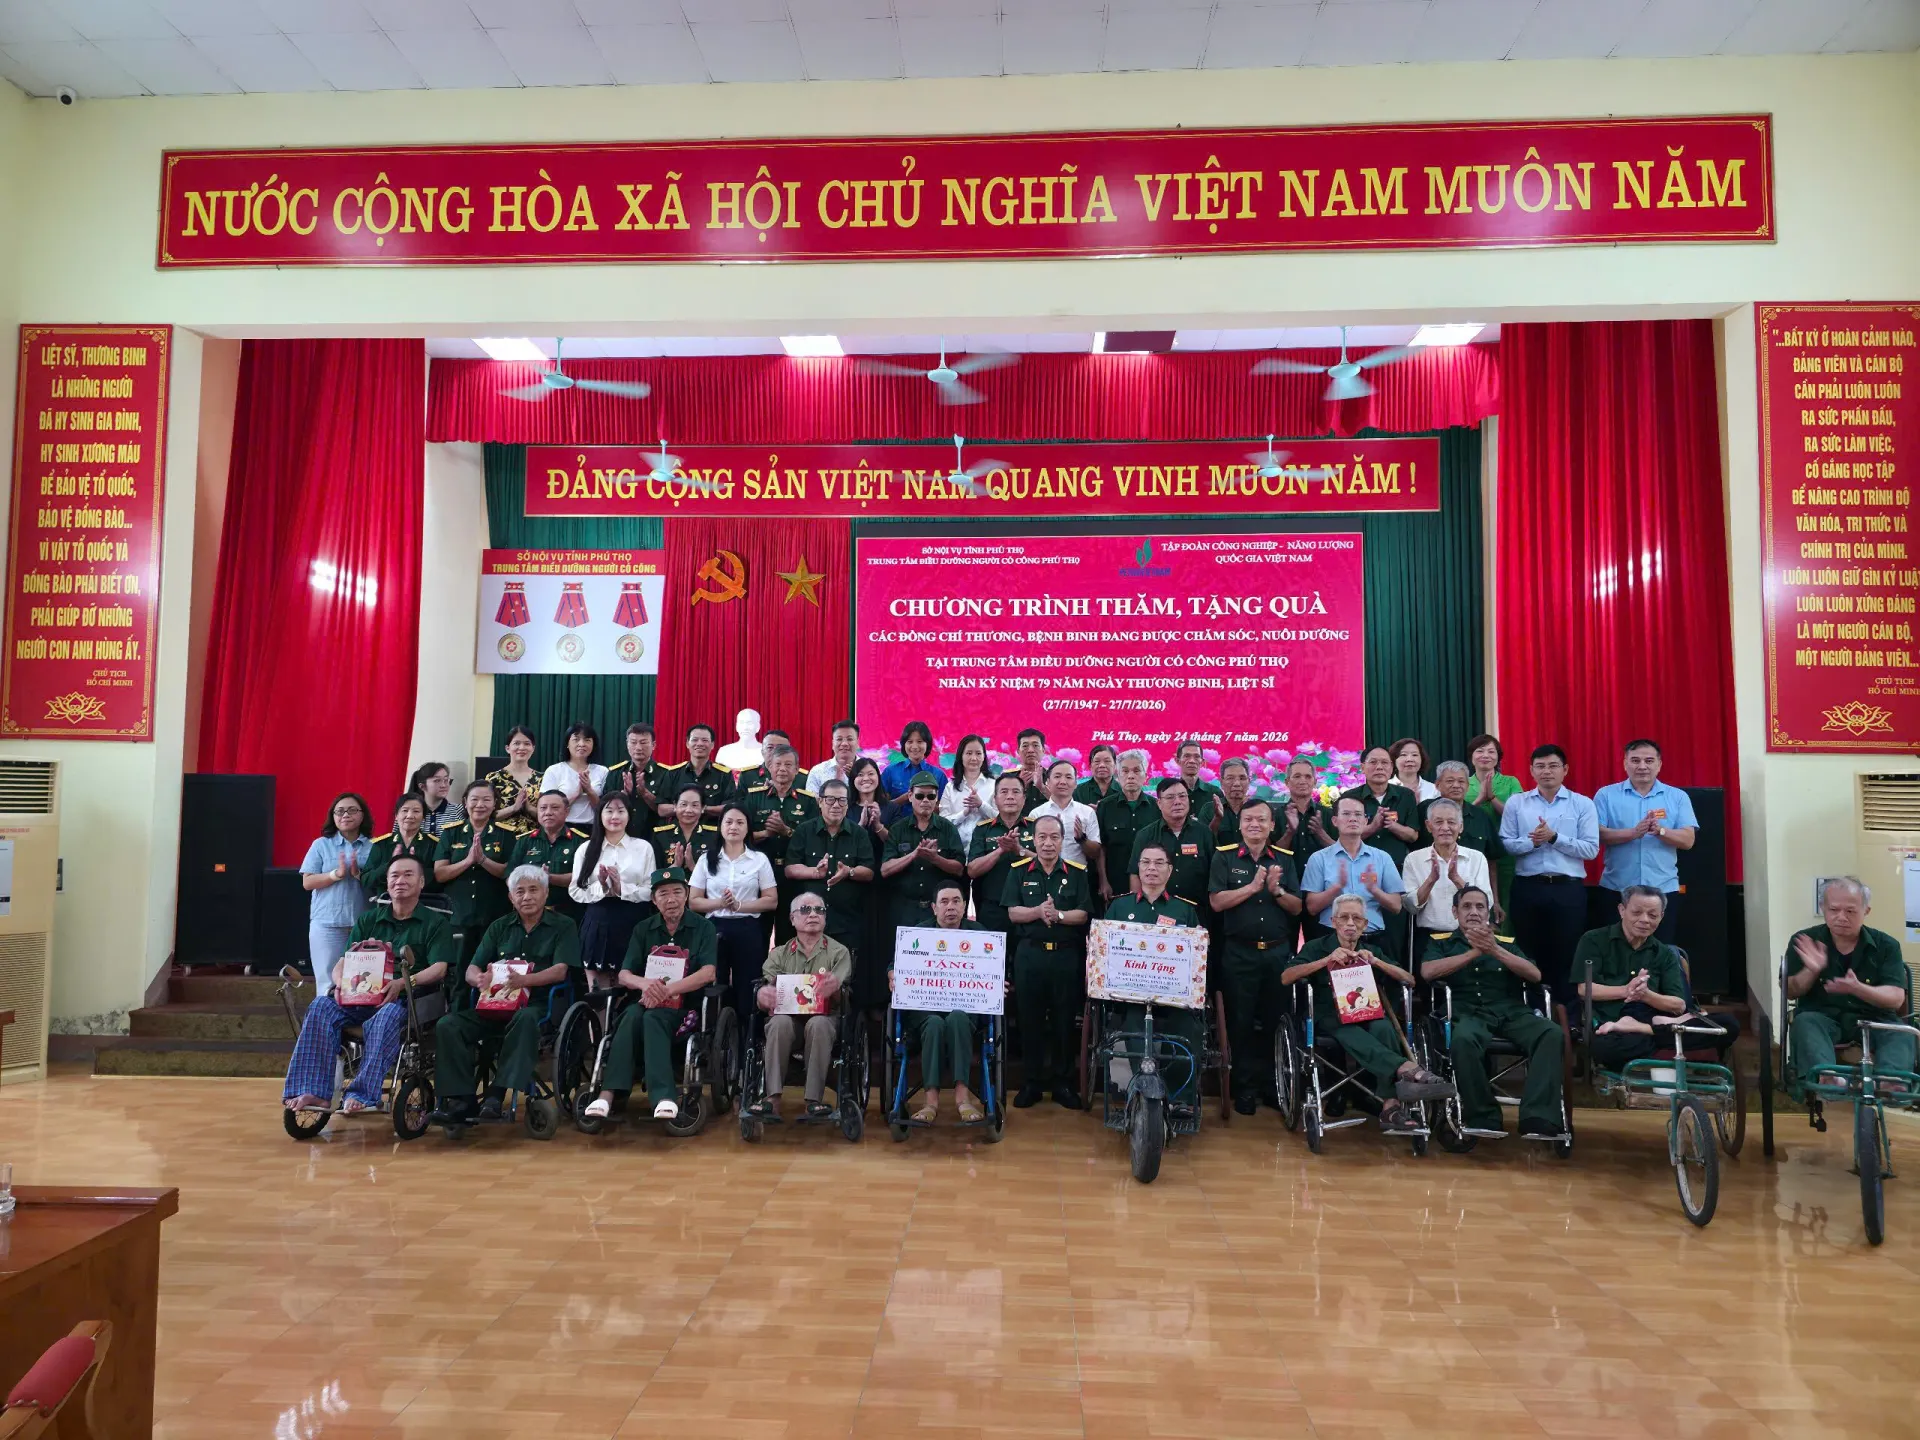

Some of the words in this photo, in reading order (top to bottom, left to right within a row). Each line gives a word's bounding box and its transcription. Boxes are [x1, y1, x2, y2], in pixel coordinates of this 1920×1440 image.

[181, 173, 319, 237] NƯỚC
[333, 172, 475, 246] CỘNG
[487, 168, 599, 233] HÒA
[614, 170, 690, 231] XÃ
[706, 165, 801, 243] HỘI
[818, 155, 925, 229] CHỦ
[941, 163, 1117, 227] NGHĨA
[1134, 155, 1263, 235] VIỆT
[1278, 166, 1409, 218] NAM
[1423, 146, 1595, 215] MUÔN
[1612, 146, 1748, 210] NĂM
[1806, 328, 1819, 347] KỲ
[1822, 325, 1830, 347] Ở
[1831, 328, 1860, 346] HOÀN
[1861, 325, 1890, 346] CẢNH
[1892, 328, 1917, 348] NÀO,
[41, 342, 62, 370] LIỆT
[64, 343, 79, 368] SỸ,
[82, 345, 120, 366] THƯƠNG
[122, 347, 147, 366] BINH
[1793, 351, 1822, 373] ĐẢNG
[1824, 354, 1847, 373] VIÊN
[1849, 354, 1863, 373] VÀ
[1865, 354, 1887, 373] CÁN
[1889, 354, 1904, 376] BỘ
[51, 375, 64, 398] LÀ
[66, 375, 100, 398] NHỮNG
[102, 374, 133, 398] NGƯỜI
[39, 408, 53, 430] ĐÃ
[55, 411, 68, 431] HY
[70, 411, 95, 431] SINH
[96, 412, 113, 431] GIA
[115, 408, 142, 433] ĐÌNH,
[1801, 410, 1816, 426] RA
[1818, 406, 1839, 426] SỨC
[1840, 406, 1870, 426] PHẤN
[1871, 406, 1896, 426] ĐẤU,
[546, 454, 638, 499] ĐẢNG
[645, 460, 736, 506] CỘNG
[743, 453, 809, 499] SẢN
[817, 459, 894, 506] VIỆT
[901, 469, 977, 500] NAM
[985, 465, 1104, 502] QUANG
[1112, 465, 1200, 497] VINH
[1320, 455, 1401, 495] NĂM
[38, 503, 58, 528] BẢO
[60, 507, 73, 529] VỆ
[74, 504, 103, 528] ĐỒNG
[104, 505, 132, 528] BÀO...
[922, 546, 934, 554] SỞ
[934, 546, 949, 556] NỘI
[950, 547, 962, 556] VỤ
[986, 545, 1005, 554] PHÚ
[1006, 546, 1024, 555] THỌ
[1161, 541, 1180, 552] TẬP
[1181, 541, 1210, 551] ĐOÀN
[1211, 540, 1240, 550] CÔNG
[1241, 540, 1278, 551] NGHIỆP
[1287, 540, 1316, 550] NĂNG
[1318, 540, 1354, 550] LƯỢNG
[1801, 541, 1833, 558] CHÍNH
[1835, 543, 1851, 560] TRỊ
[1853, 537, 1875, 559] CỦA
[1876, 541, 1908, 559] MÌNH.
[516, 550, 530, 561] SỞ
[532, 551, 549, 562] NỘI
[551, 553, 564, 562] VỤ
[591, 551, 611, 561] PHÚ
[612, 553, 632, 562] THỌ
[1245, 554, 1264, 563] GIA
[1264, 553, 1288, 564] VIỆT
[1288, 554, 1312, 562] NAM
[492, 564, 520, 573] TRUNG
[522, 563, 539, 573] TÂM
[562, 563, 590, 573] DƯỠNG
[592, 563, 618, 573] NGƯỜI
[620, 563, 632, 573] CÓ
[633, 563, 656, 573] CÔNG
[31, 600, 54, 627] PHẢI
[57, 603, 80, 627] GIÚP
[82, 603, 97, 626] ĐỠ
[98, 603, 133, 627] NHỮNG
[890, 596, 1003, 617] CHƯƠNG
[1008, 594, 1090, 616] TRÌNH
[1096, 592, 1182, 619] THĂM,
[1188, 594, 1263, 620] TẶNG
[1269, 592, 1328, 618] QUÀ
[868, 630, 896, 642] CÁC
[938, 630, 963, 642] CHÍ
[964, 630, 1025, 643] THƯƠNG,
[1027, 630, 1064, 644] BỆNH
[1066, 632, 1098, 642] BINH
[1101, 631, 1140, 641] ĐANG
[1142, 630, 1181, 643] ĐƯỢC
[1184, 628, 1226, 641] CHĂM
[1228, 628, 1259, 642] SÓC,
[1261, 628, 1296, 640] NUÔI
[1298, 628, 1350, 640] DƯỠNG
[1797, 620, 1810, 639] LÀ
[1813, 620, 1834, 642] MỘT
[1837, 620, 1869, 640] NGƯỜI
[1872, 621, 1893, 640] CÁN
[1896, 622, 1913, 644] BỘ,
[16, 635, 47, 659] NGƯỜI
[49, 639, 70, 659] CON
[72, 640, 93, 660] ANH
[95, 637, 122, 660] HÙNG
[125, 634, 141, 660] ẤY.
[86, 676, 98, 686] HỒ
[98, 678, 111, 686] CHÍ
[938, 676, 976, 688] NHÂN
[978, 676, 998, 688] KỶ
[1000, 677, 1035, 690] NIỆM
[1037, 678, 1051, 688] 79
[1052, 676, 1084, 688] NĂM
[1086, 676, 1125, 688] NGÀY
[1126, 677, 1185, 688] THƯƠNG
[1188, 678, 1225, 690] BINH,
[1227, 676, 1259, 690] LIỆT
[1261, 676, 1275, 688] SĨ
[1875, 675, 1892, 684] CHỦ
[1894, 678, 1914, 686] TỊCH
[1042, 699, 1099, 712] (27/7/1947
[1109, 700, 1166, 712] 27/7/2026)
[1091, 731, 1114, 741] Phú
[1118, 731, 1142, 743] Thọ,
[1144, 731, 1172, 744] ngày
[1173, 731, 1188, 742] 24
[1189, 732, 1222, 744] tháng
[1225, 732, 1233, 742] 7
[1234, 732, 1259, 742] năm
[1261, 732, 1289, 742] 2026
[924, 958, 975, 970] TẶNG
[1151, 962, 1176, 974] Tặng
[903, 977, 916, 986] 30
[918, 978, 956, 990] TRIỆU
